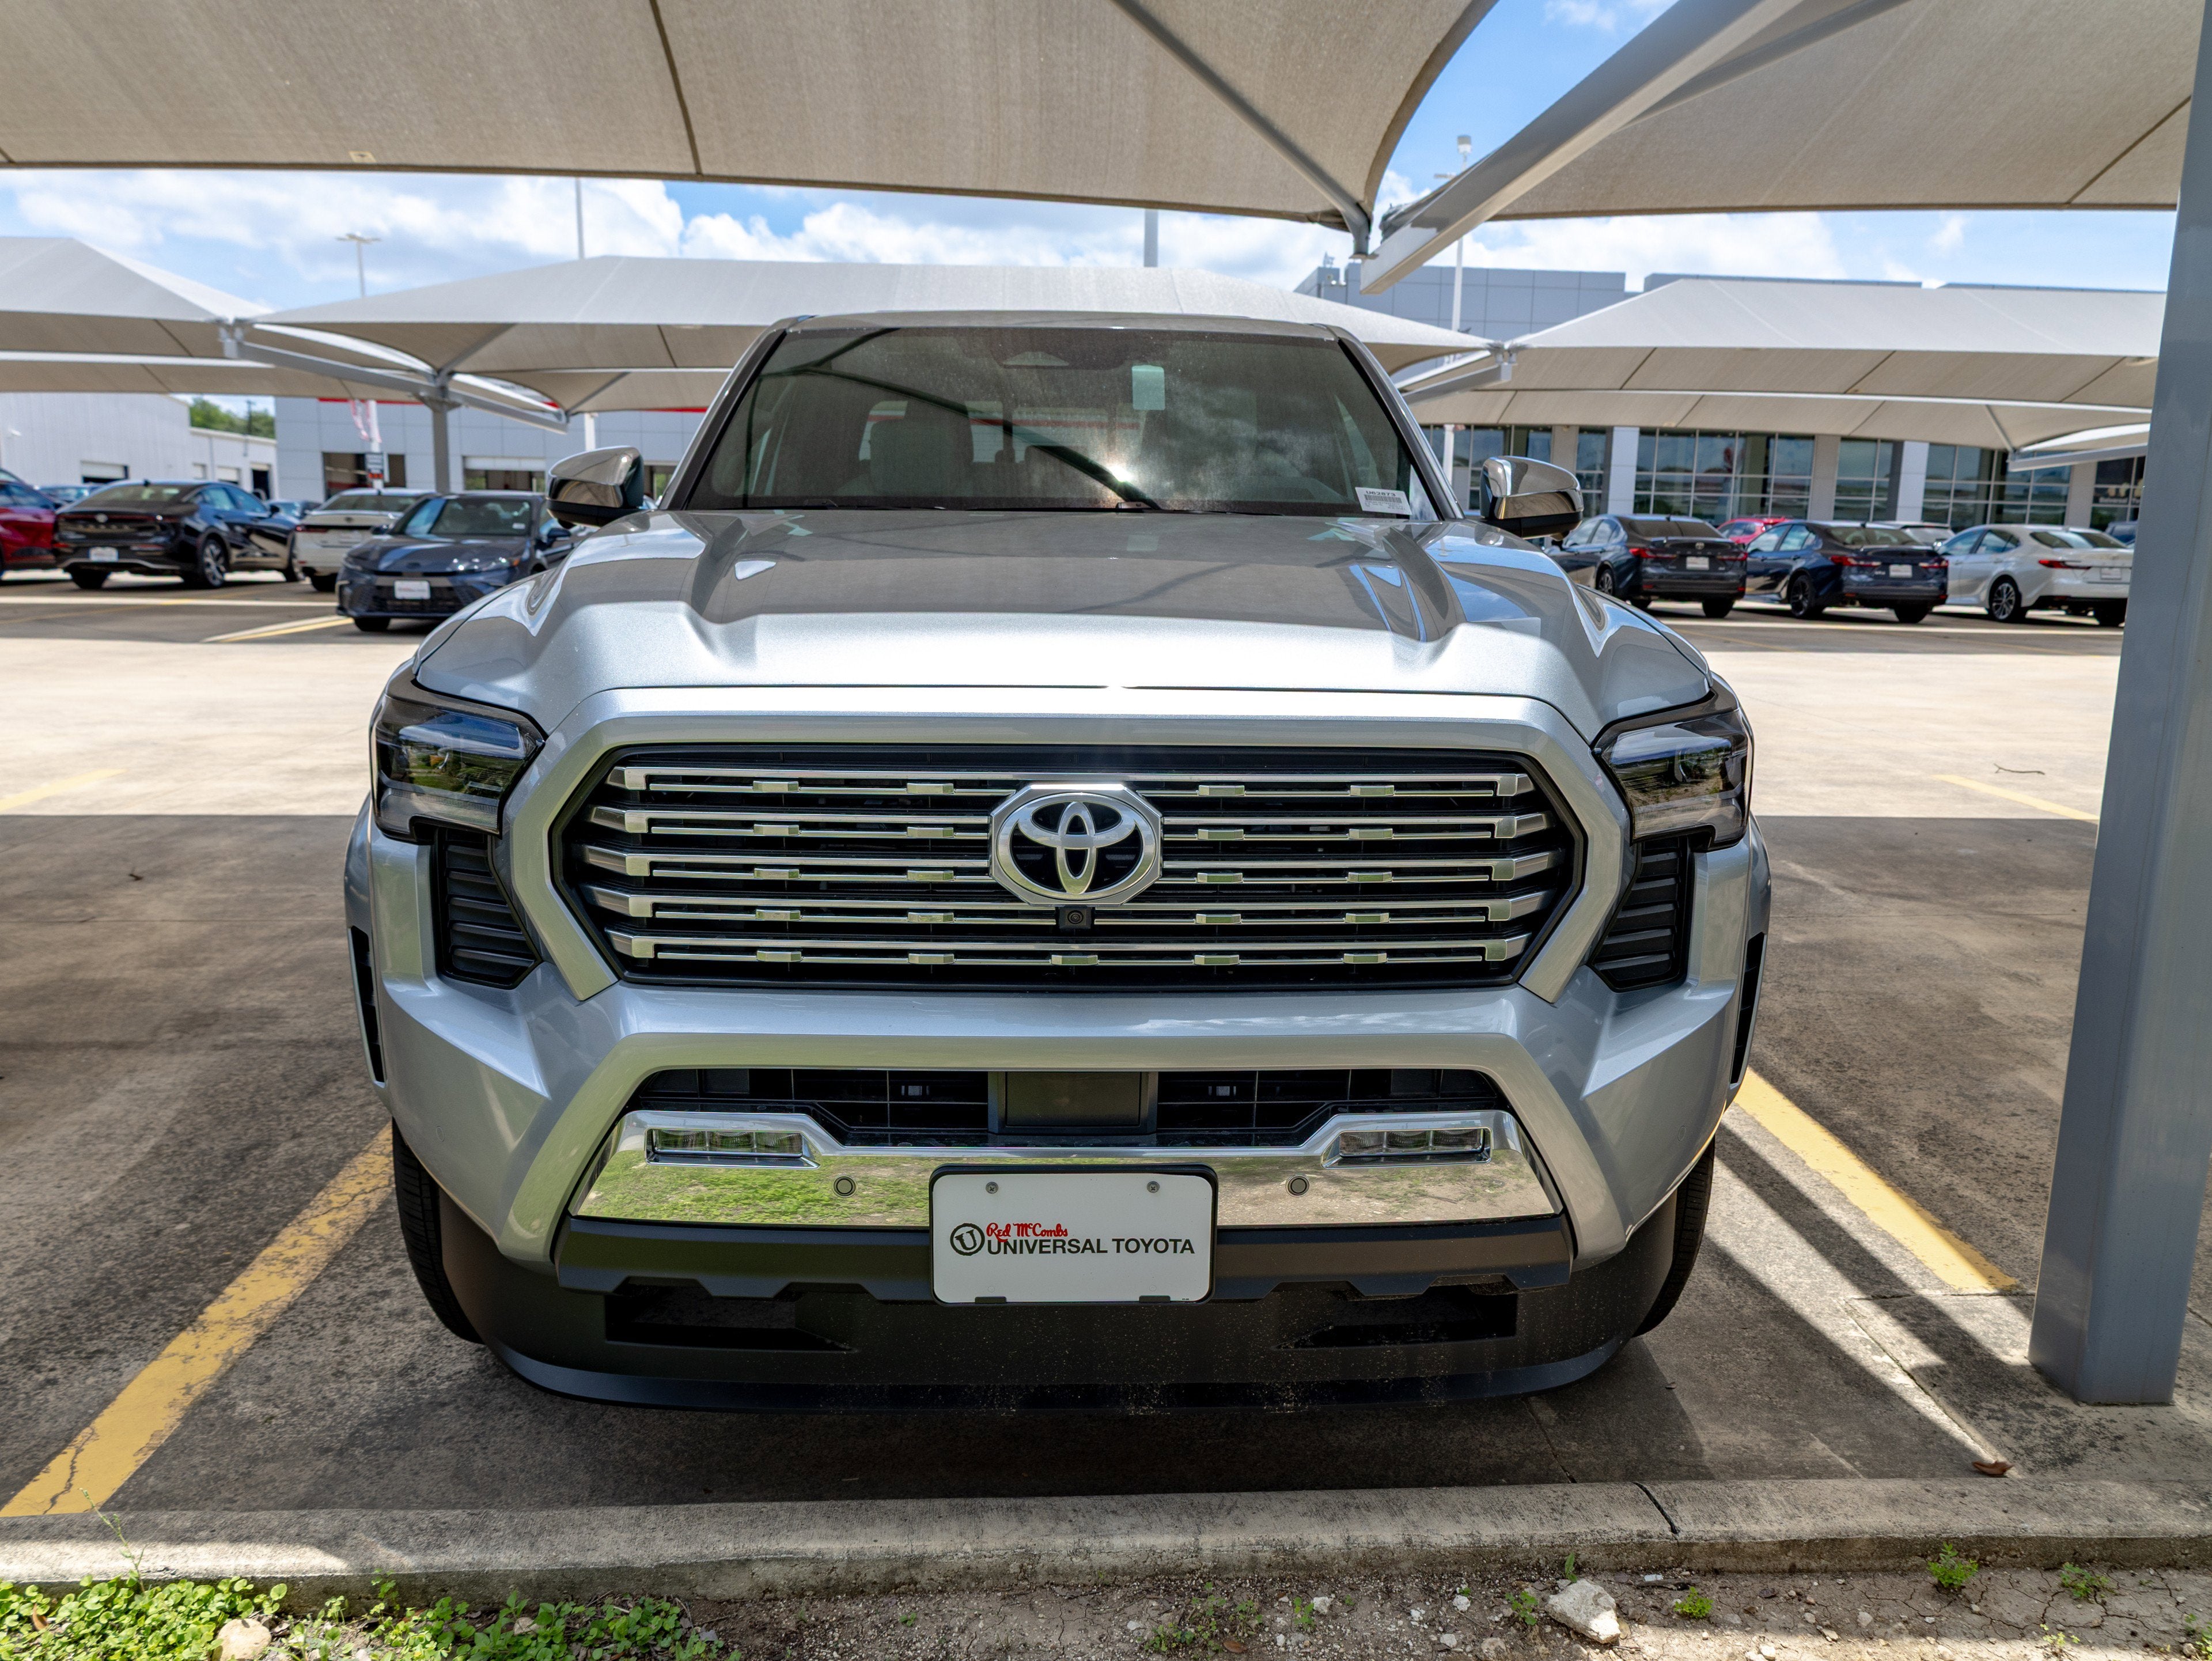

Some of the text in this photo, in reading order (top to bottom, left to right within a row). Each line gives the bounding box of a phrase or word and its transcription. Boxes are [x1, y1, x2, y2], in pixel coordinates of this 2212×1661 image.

[987, 1222, 1068, 1243] Red McCombs
[987, 1238, 1195, 1255] UNIVERSAL TOYOTA
